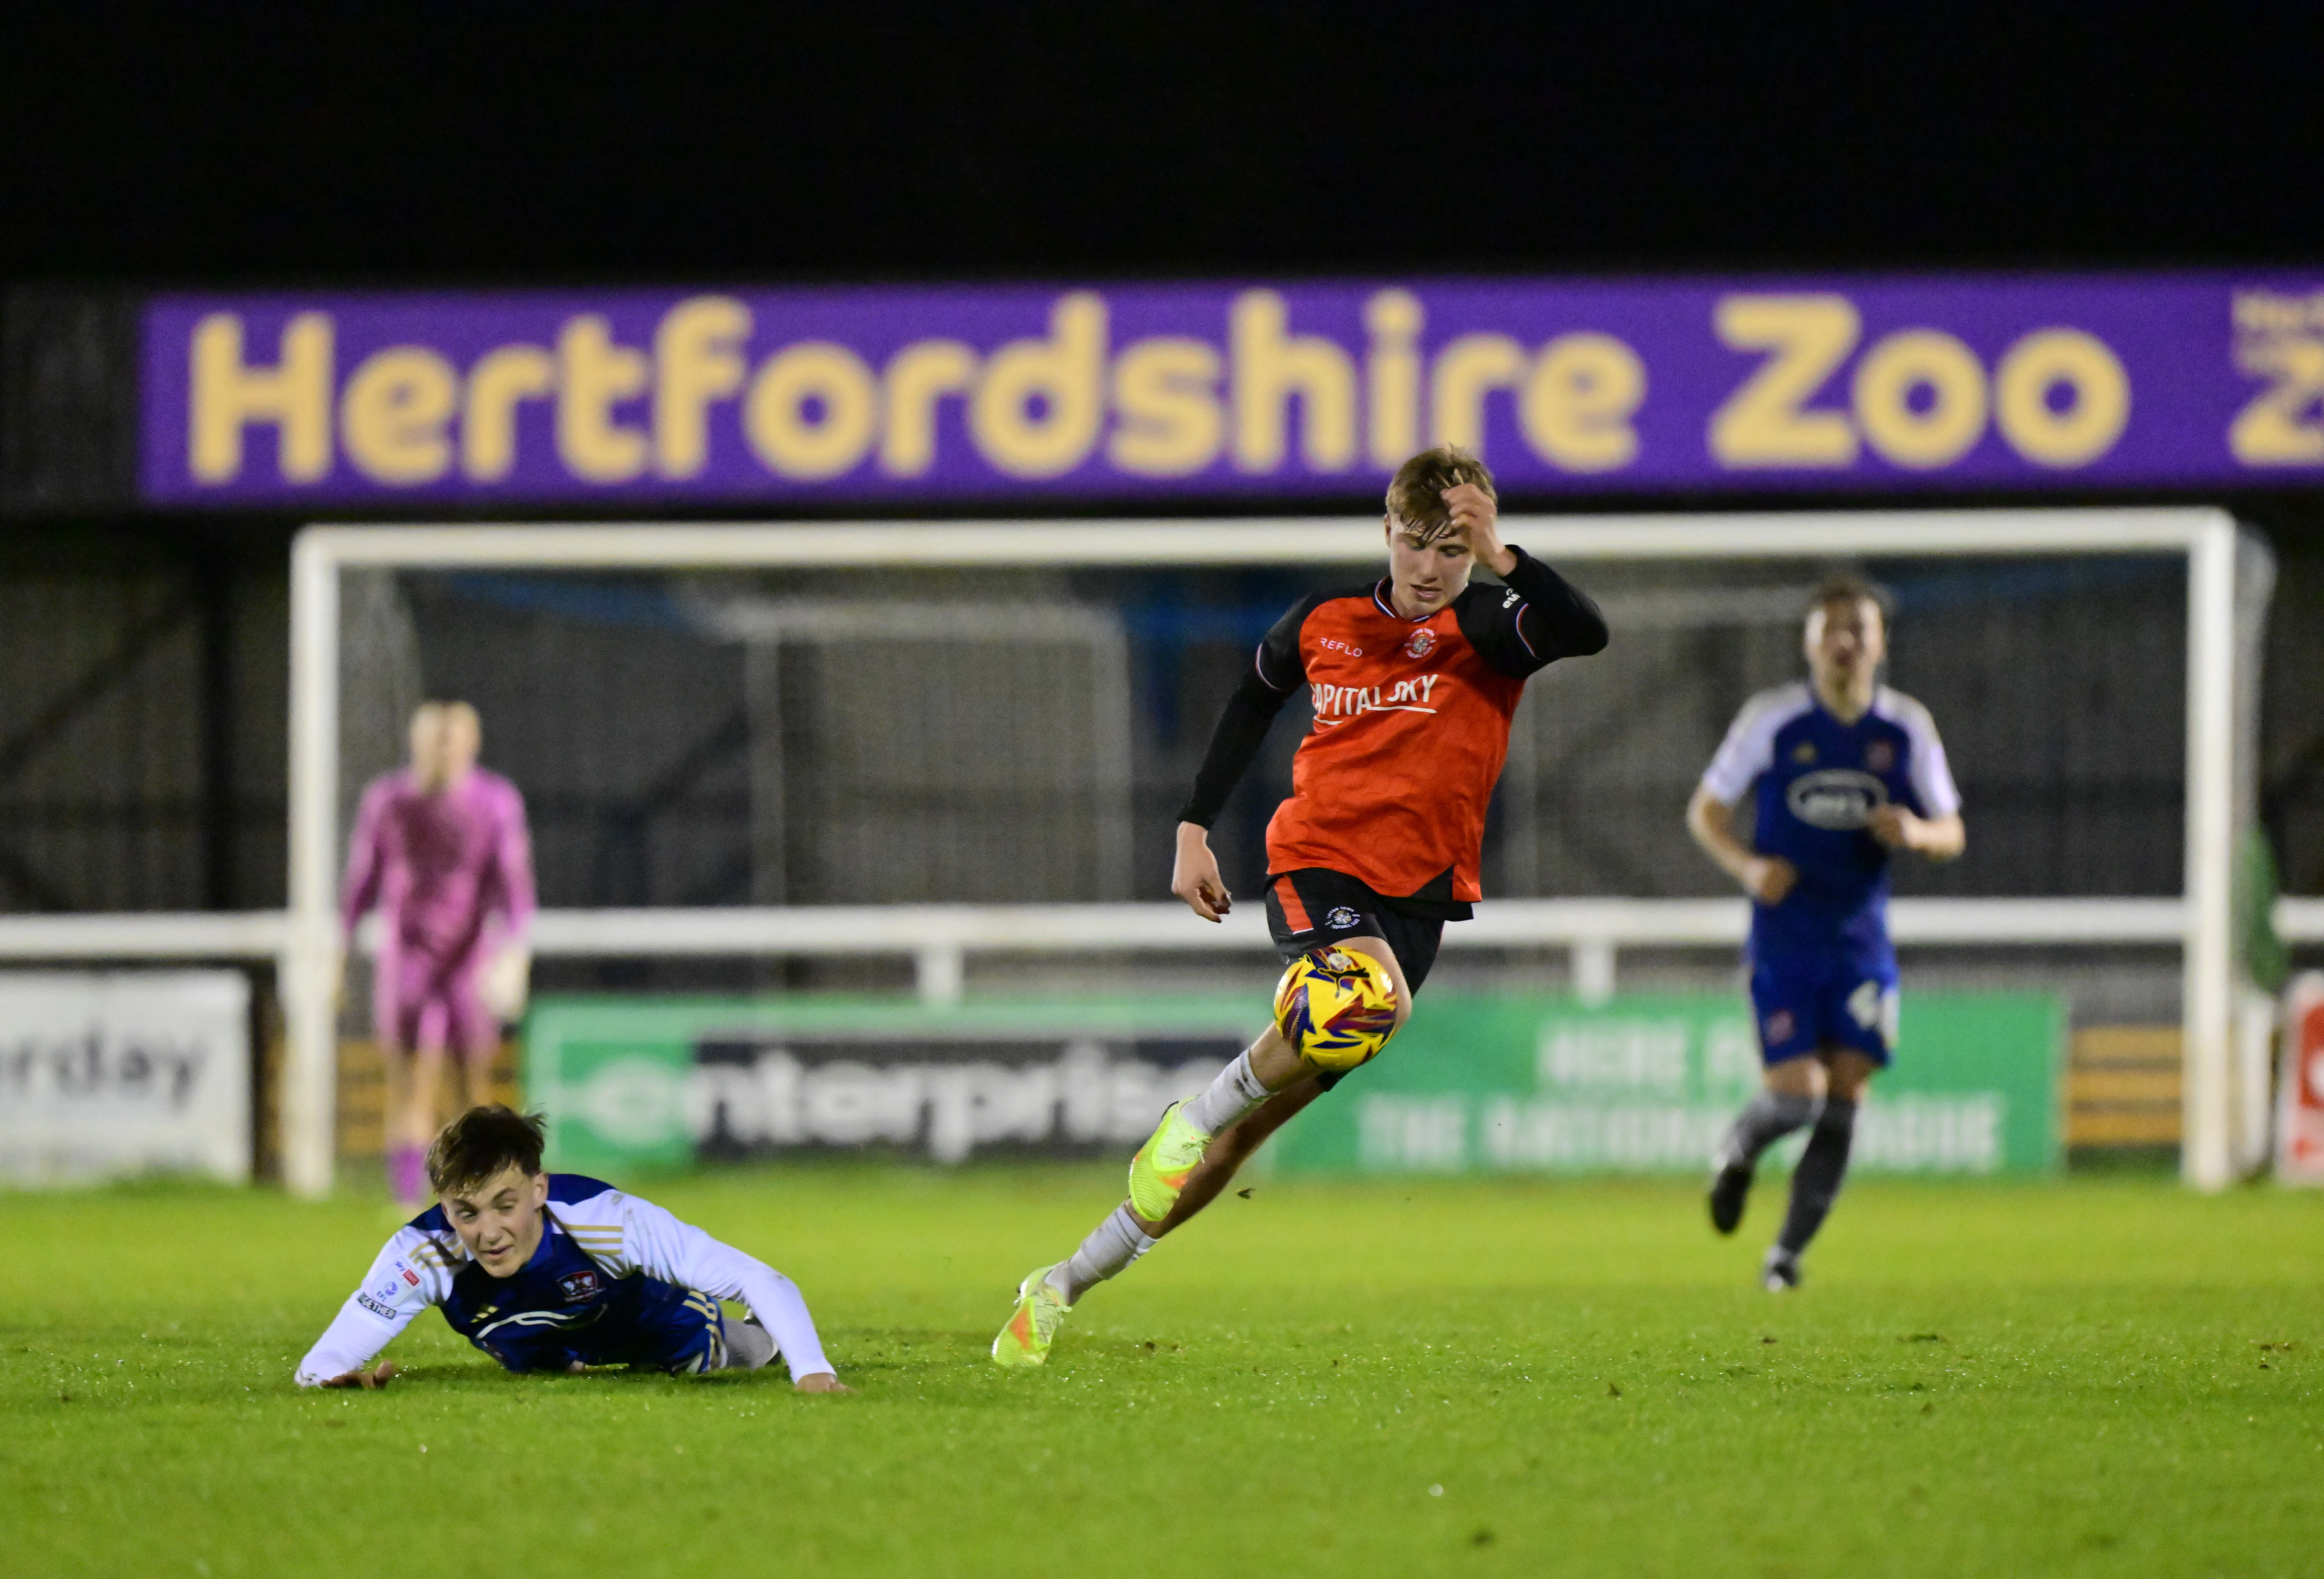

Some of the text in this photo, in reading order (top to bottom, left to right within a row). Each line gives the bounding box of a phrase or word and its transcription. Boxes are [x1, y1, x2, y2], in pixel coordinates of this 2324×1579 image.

[189, 290, 1647, 482] Hertfordshire
[1709, 293, 2132, 471] Zoo
[1320, 637, 1362, 657] REFLO
[0, 1020, 210, 1117] rday
